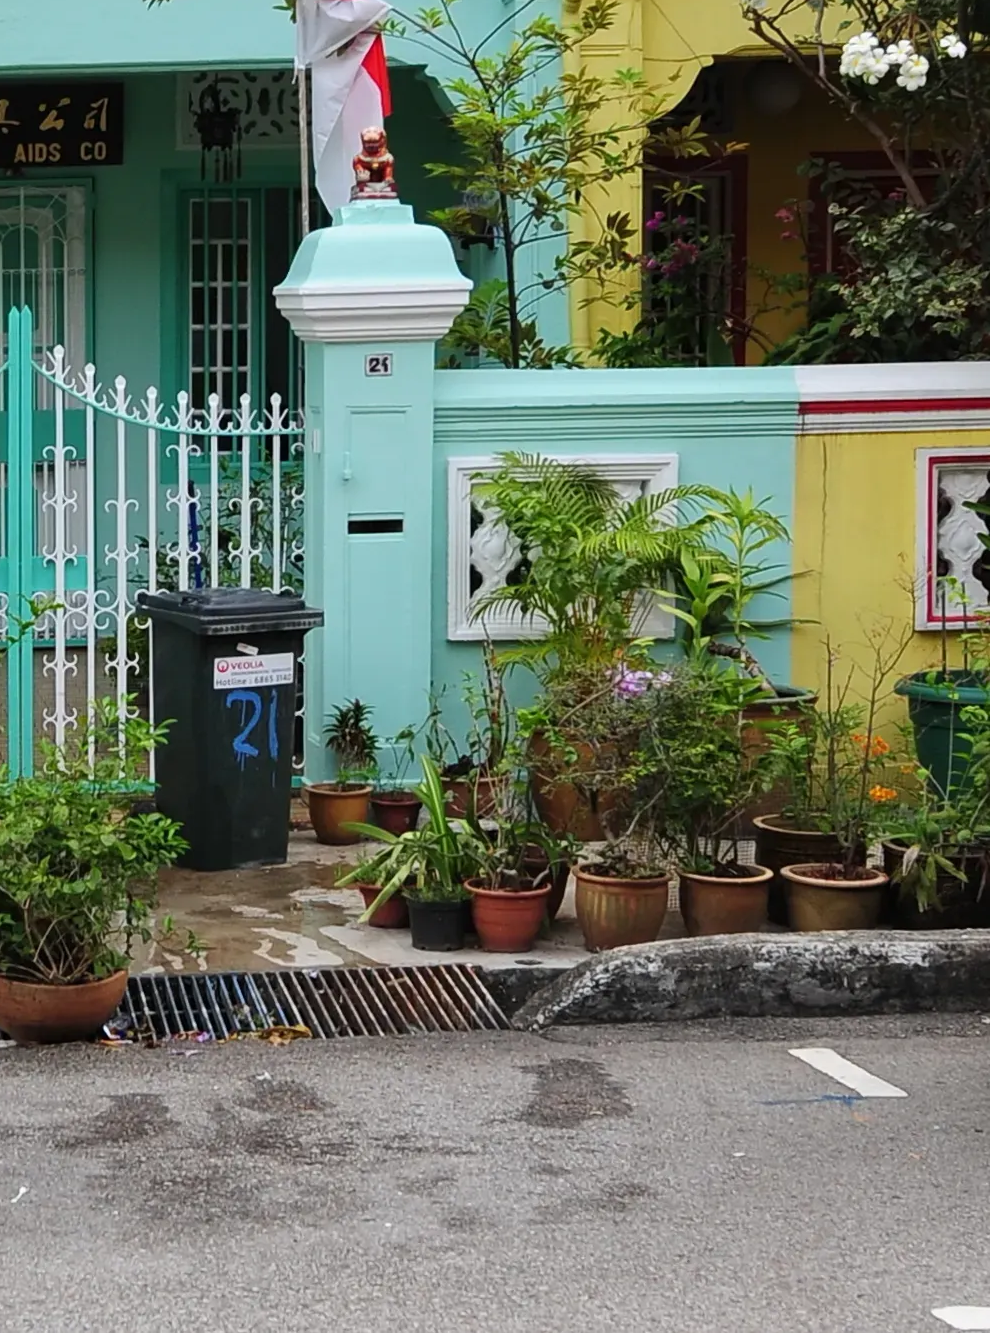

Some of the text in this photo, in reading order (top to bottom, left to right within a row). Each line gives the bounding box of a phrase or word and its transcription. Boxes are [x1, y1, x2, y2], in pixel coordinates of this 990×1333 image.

[14, 143, 61, 164] AIDS
[80, 141, 107, 161] CO
[368, 356, 389, 373] 21
[231, 661, 264, 670] VEOLIA
[216, 677, 247, 687] Hotline
[226, 689, 279, 761] 21
